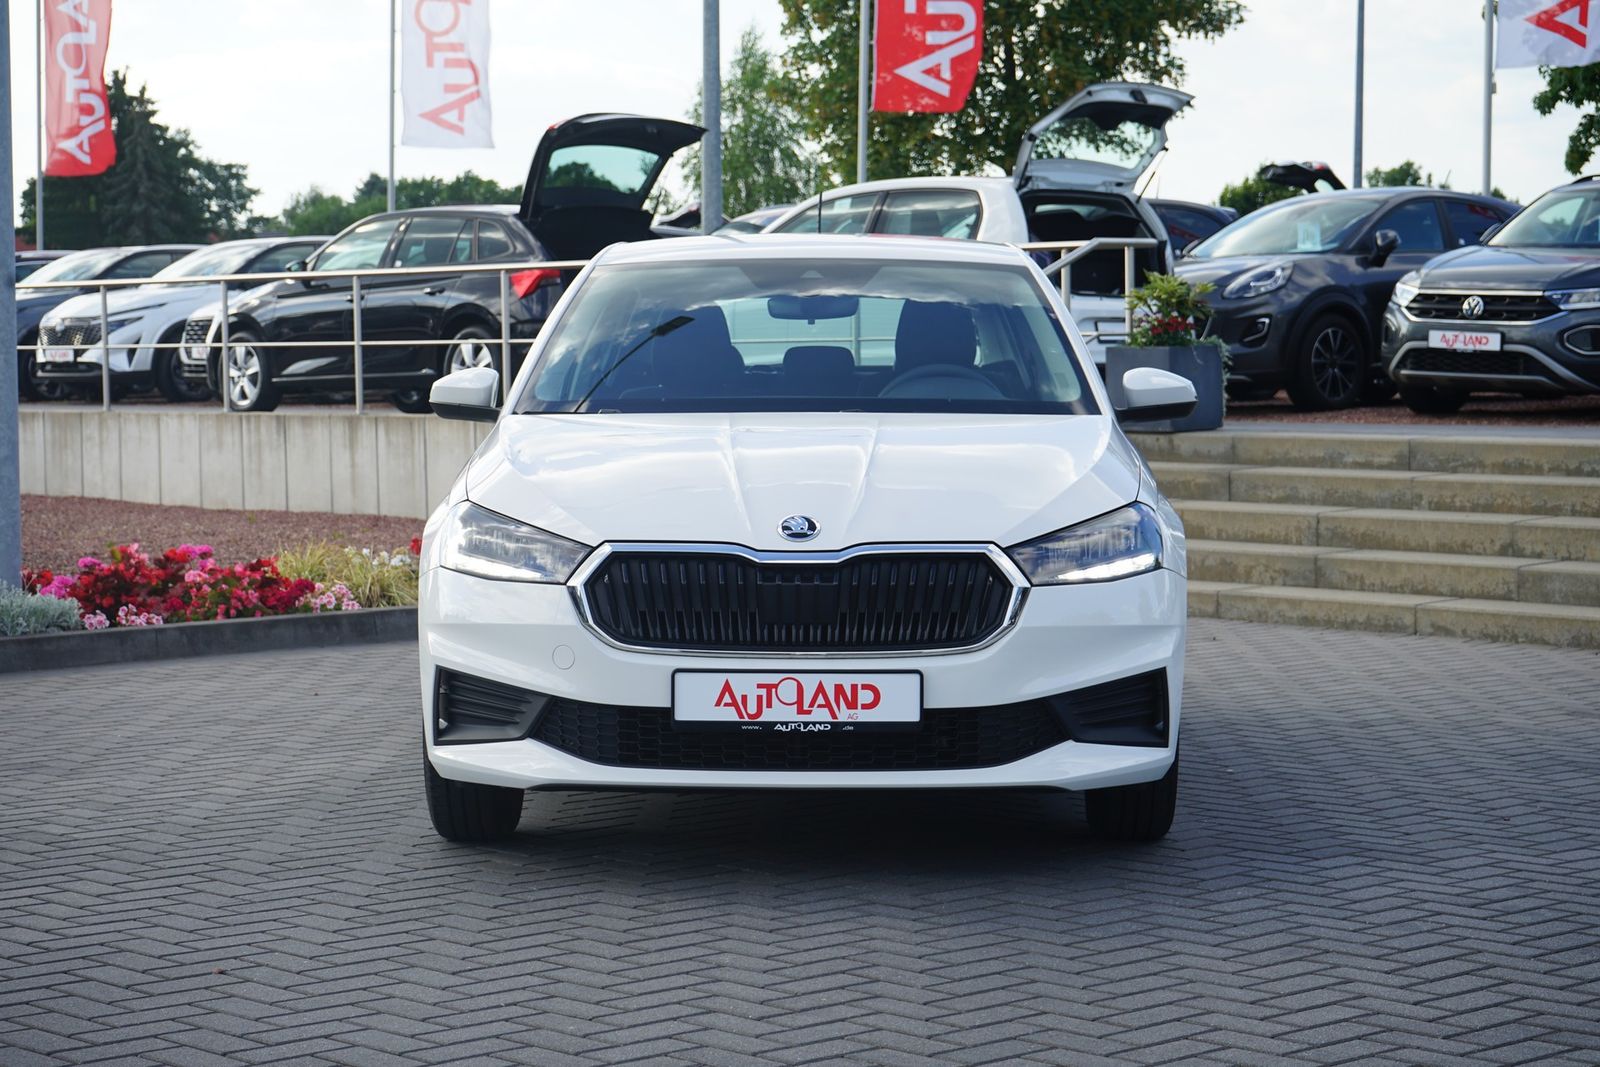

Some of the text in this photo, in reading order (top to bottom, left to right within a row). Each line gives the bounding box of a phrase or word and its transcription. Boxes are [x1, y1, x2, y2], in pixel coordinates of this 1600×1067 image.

[415, 0, 481, 135] AUTO
[714, 676, 881, 720] AUTOLAND
[774, 722, 831, 732] AUTOLAND
[846, 712, 859, 720] AG
